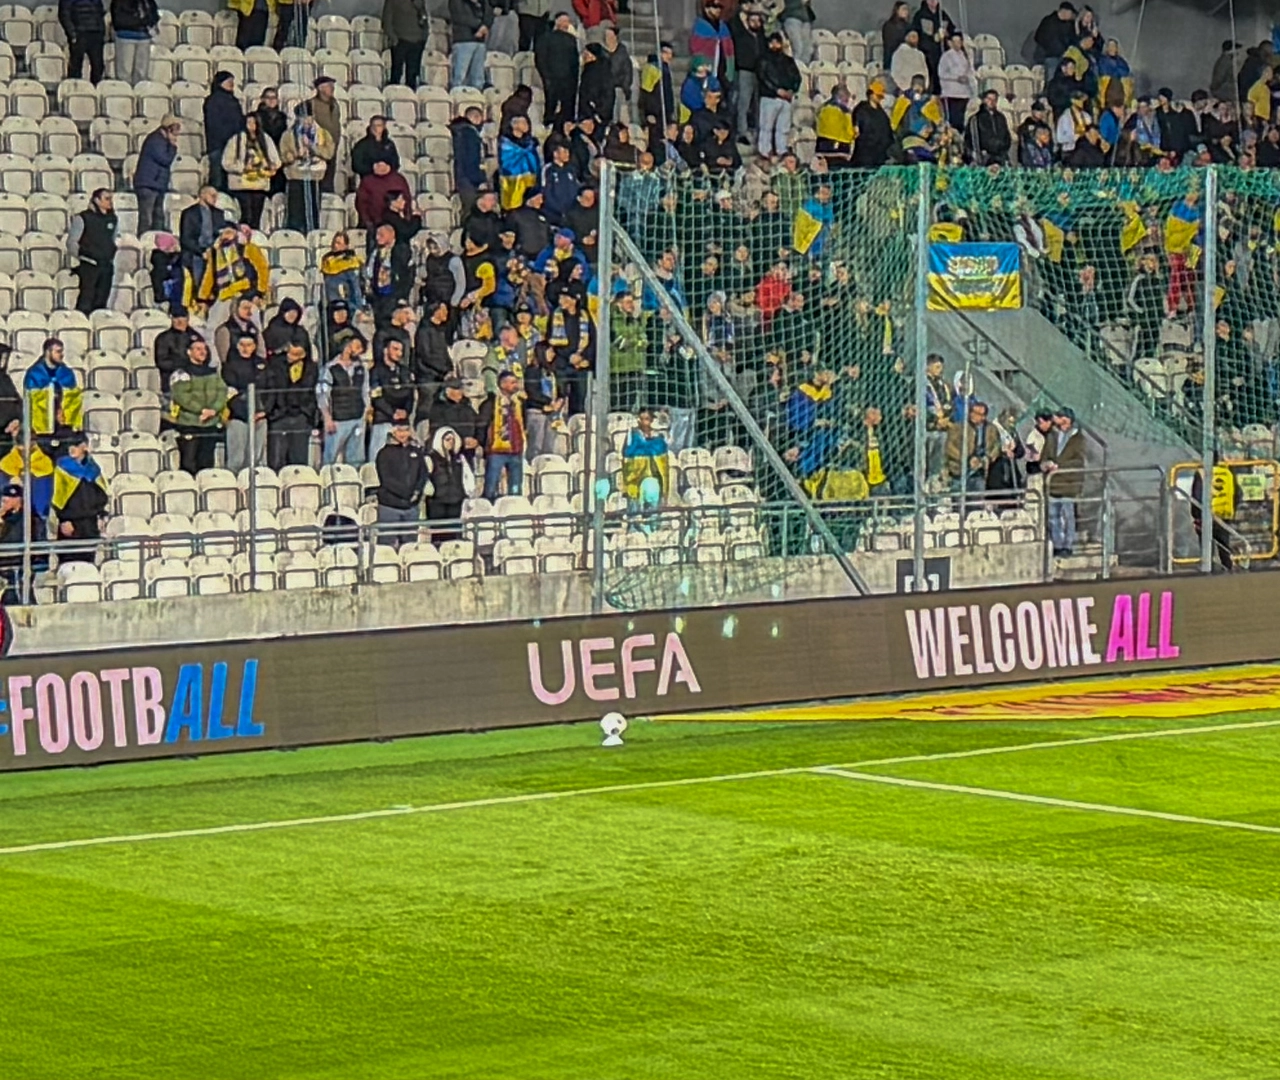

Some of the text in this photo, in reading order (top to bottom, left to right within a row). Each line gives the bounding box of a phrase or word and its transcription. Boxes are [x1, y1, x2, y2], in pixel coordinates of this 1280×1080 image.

[527, 632, 702, 706] UEFA
[905, 590, 1180, 679] WELCOME ALL
[0, 658, 265, 757] FOOTBALL
